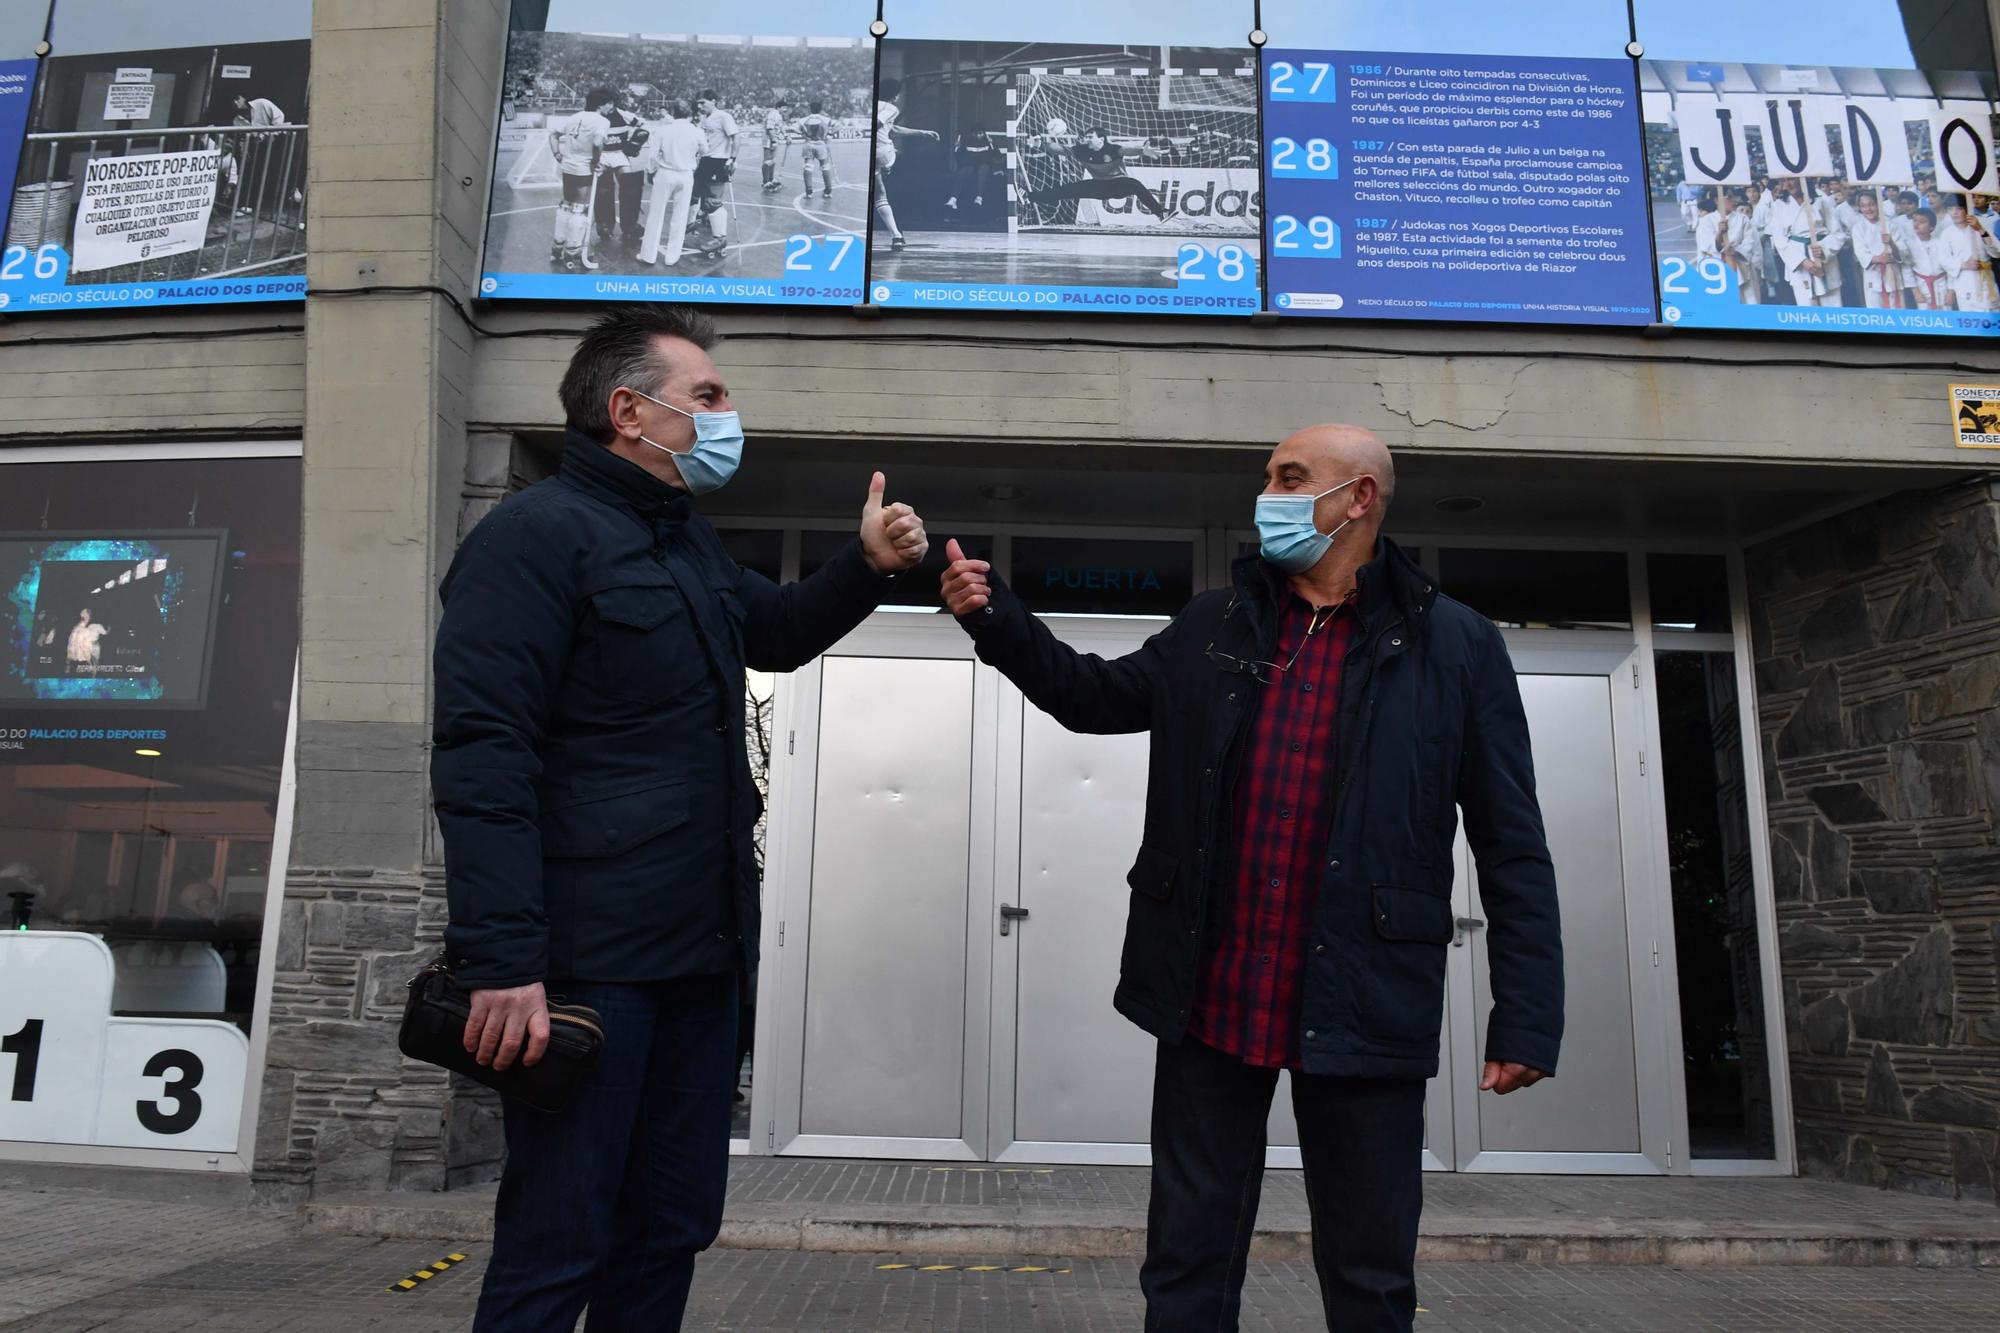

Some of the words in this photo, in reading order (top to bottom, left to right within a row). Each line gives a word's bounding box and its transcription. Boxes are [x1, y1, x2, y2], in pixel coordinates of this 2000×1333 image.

[1271, 62, 1329, 94] 27
[1350, 65, 1381, 74] 1986
[1394, 66, 1437, 76] Durante
[1439, 68, 1460, 77] oito
[1463, 69, 1516, 79] tempadas
[1518, 72, 1590, 81] consecutivas,
[1350, 77, 1406, 87] Dominicos
[1419, 79, 1448, 88] Liceo
[1450, 81, 1509, 90] coincidiron
[1528, 83, 1570, 92] División
[1573, 84, 1586, 93] de
[1589, 85, 1624, 94] Honra.
[1350, 89, 1367, 98] Foi
[1387, 91, 1429, 100] período
[1431, 92, 1445, 101] de
[1448, 93, 1491, 102] máximo
[1493, 94, 1547, 104] esplendor
[1550, 97, 1573, 105] para
[1586, 96, 1624, 107] hóckey
[1351, 103, 1396, 112] coruñés,
[1399, 105, 1420, 113] que
[1422, 105, 1473, 114] propiciou
[1476, 106, 1510, 115] derbis
[1512, 108, 1543, 116] como
[1545, 109, 1568, 117] este
[1571, 109, 1584, 117] de
[1587, 109, 1612, 118] 1986
[1368, 117, 1389, 125] que
[1407, 116, 1449, 126] liceístas
[1452, 118, 1497, 127] gañaron
[1499, 120, 1518, 128] por
[1521, 119, 1540, 128] 4-3
[1272, 137, 1331, 171] 28
[1352, 140, 1384, 149] 1987
[1396, 142, 1419, 151] Con
[1421, 144, 1444, 152] esta
[1447, 144, 1485, 153] parada
[1487, 145, 1501, 154] de
[1504, 145, 1530, 154] Julio
[1558, 147, 1589, 157] belga
[87, 160, 160, 182] NOROESTE
[162, 155, 221, 175] POP-ROCK
[1353, 154, 1394, 163] quenda
[1396, 155, 1411, 163] de
[1414, 155, 1458, 166] penaltis,
[1461, 156, 1501, 167] España
[1504, 158, 1573, 168] proclamouse
[1576, 161, 1622, 170] campioa
[1353, 166, 1368, 175] do
[1371, 166, 1408, 176] Torneo
[1411, 167, 1437, 176] FIFA
[1439, 169, 1454, 177] de
[1456, 169, 1489, 178] fútbol
[1492, 170, 1516, 180] sala,
[1518, 171, 1573, 181] disputado
[1576, 173, 1605, 182] polas
[1608, 174, 1629, 183] oito
[86, 183, 108, 196] ESTA
[110, 179, 154, 194] PROHIBIDO
[1354, 179, 1400, 188] mellores
[1402, 180, 1459, 190] seleccións
[1461, 182, 1476, 191] do
[1479, 183, 1520, 192] mundo.
[1522, 183, 1555, 193] Outro
[1557, 185, 1602, 195] xogador
[1605, 186, 1620, 195] do
[124, 191, 163, 206] BOTELLAS
[177, 187, 201, 198] VIDRIO
[1354, 191, 1402, 202] Chaston,
[1405, 193, 1442, 203] Vituco,
[1445, 195, 1488, 204] recolleu
[1502, 195, 1535, 205] trofeo
[1538, 198, 1569, 206] como
[1571, 198, 1612, 208] capitán
[85, 208, 132, 224] CUALQUIER
[156, 201, 185, 214] OBJETO
[96, 217, 157, 236] ORGANIZACION
[159, 211, 200, 226] CONSIDERE
[1275, 215, 1334, 249] 29
[1356, 218, 1387, 227] 1987
[1400, 220, 1446, 230] Judokas
[1449, 223, 1468, 231] nos
[1471, 222, 1506, 233] Xogos
[1509, 223, 1569, 233] Deportivos
[1572, 225, 1623, 235] Escolares
[126, 228, 170, 243] PELIGROSO
[1356, 231, 1370, 241] de
[1373, 232, 1399, 241] 1987.
[1402, 233, 1426, 242] Esta
[1429, 234, 1486, 244] actividade
[1489, 235, 1503, 244] foi
[1516, 238, 1563, 246] semente
[1565, 238, 1580, 247] do
[1583, 238, 1617, 248] trofeo
[785, 234, 854, 272] 27
[1356, 245, 1409, 255] Miguelito,
[1441, 247, 1487, 257] primeira
[1489, 248, 1530, 258] edición
[1533, 251, 1545, 259] se
[1548, 250, 1596, 260] celebrou
[1598, 252, 1626, 261] dous
[1, 244, 59, 280] 26
[1180, 243, 1244, 281] 28
[1356, 259, 1383, 267] anos
[1386, 258, 1429, 269] despois
[1432, 261, 1445, 269] na
[1448, 260, 1521, 271] polideportiva
[1524, 262, 1538, 271] de
[1541, 263, 1576, 272] Riazor
[1662, 257, 1727, 295] 29
[29, 292, 72, 304] MEDIO
[75, 288, 129, 302] SÉCULO
[132, 288, 154, 300] DO
[157, 286, 219, 298] PALACIO
[222, 284, 252, 295] DOS
[596, 281, 640, 293] UNHA
[645, 282, 716, 294] HISTORIA
[720, 284, 775, 296] VISUAL
[780, 286, 863, 298] 1970-2020
[914, 289, 964, 301] MEDIO
[969, 288, 1030, 302] SÉCULO
[1034, 291, 1057, 303] DO
[1062, 293, 1131, 304] PALACIO
[1135, 294, 1168, 305] DOS
[1172, 295, 1256, 308] DEPORTES
[1777, 312, 1822, 323] UNHA
[1825, 313, 1895, 326] HISTORIA
[1899, 315, 1953, 328] VISUAL
[1957, 317, 2000, 329] 1970-
[1045, 567, 1161, 590] PUERTA
[9, 728, 27, 738] DO
[29, 729, 78, 738] PALACIO
[79, 729, 104, 738] DOS
[106, 729, 166, 739] DEPORTES
[1, 1018, 44, 1102] 1
[136, 1048, 204, 1134] 3
